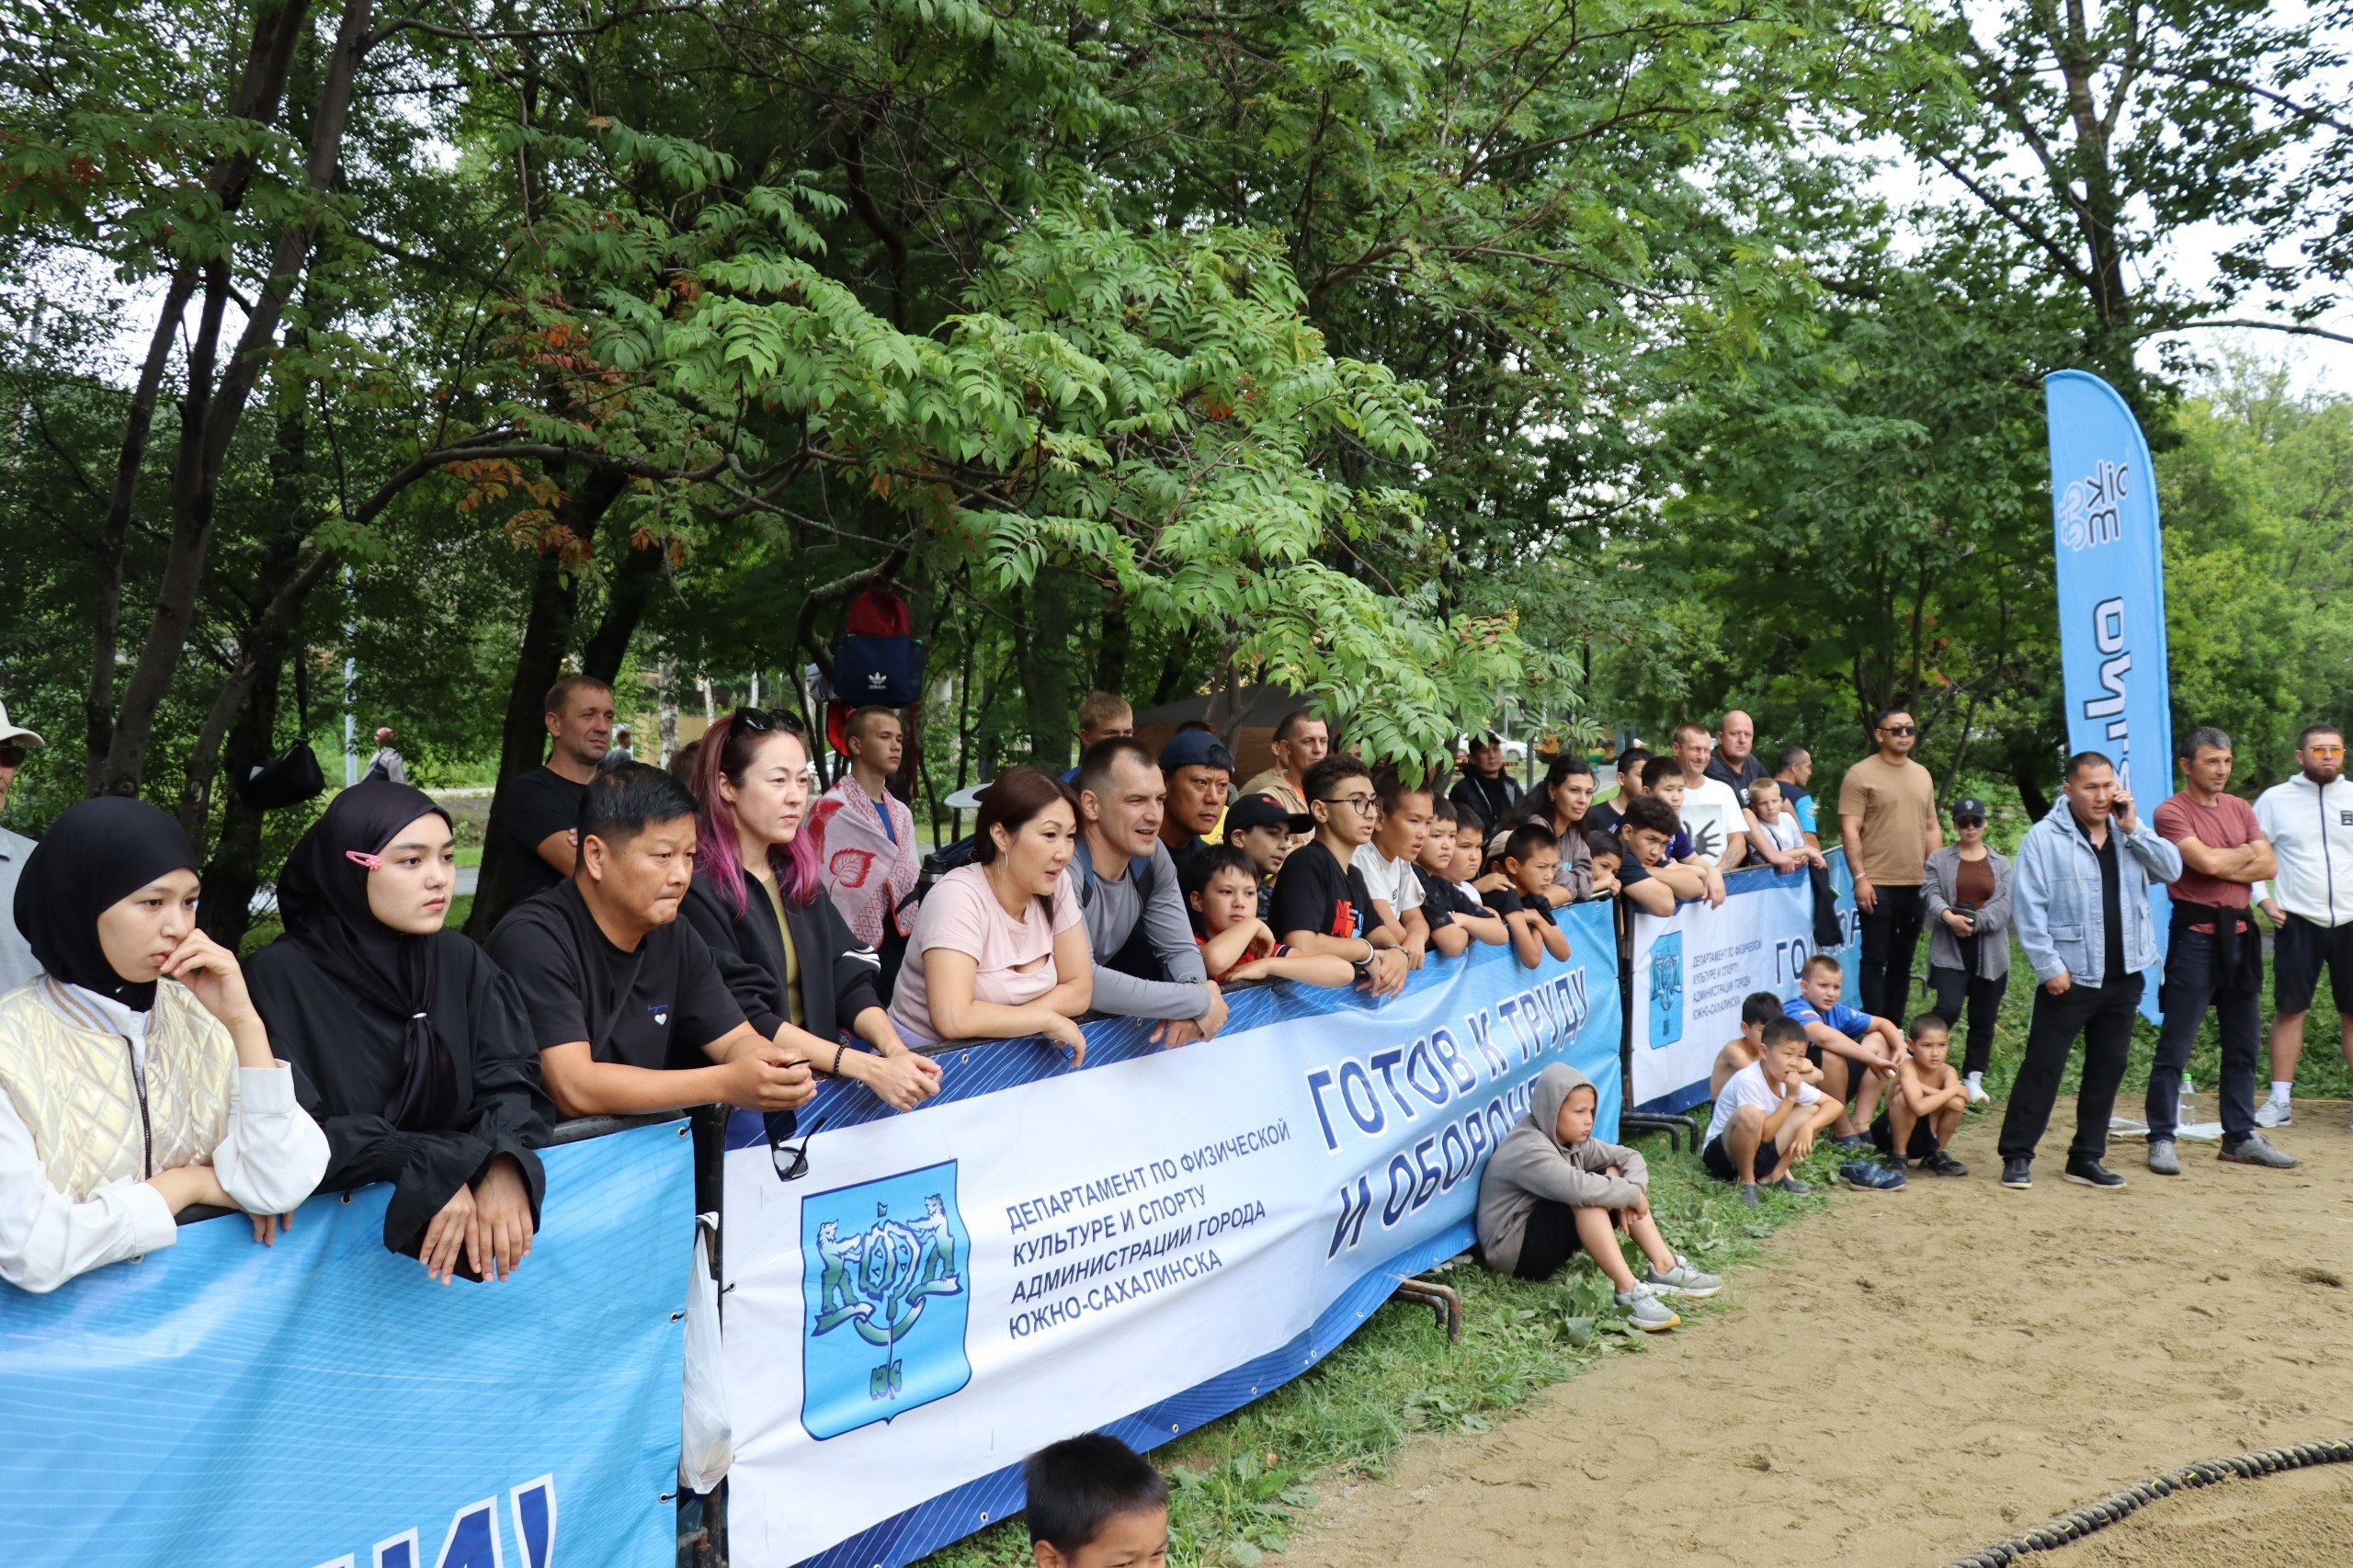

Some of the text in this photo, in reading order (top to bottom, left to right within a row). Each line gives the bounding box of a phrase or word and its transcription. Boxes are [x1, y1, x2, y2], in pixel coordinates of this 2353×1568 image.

[1693, 949, 1727, 968] ДЕПАРТАМЕНТ
[1735, 937, 1763, 955] ФИЗИЧЕСКОЙ
[1693, 962, 1740, 985] КУЛЬТУРЕ И СПОРТУ
[1693, 975, 1752, 1004] АДМИНИСТРАЦИИ ГОРОДА
[1692, 995, 1741, 1020] ЮЖНО-САХАЛИНСКА
[1306, 966, 1587, 1154] ГОТОВ К ТРУДУ
[1006, 1118, 1291, 1234] ДЕПАРТАМЕНТ ПО ФИЗИЧЕСКОЙ
[1326, 1171, 1372, 1264] И
[1011, 1199, 1267, 1304] АДМИНИСТРАЦИИ ГОРОДА
[1013, 1185, 1207, 1267] КУЛЬТУРЕ И СПОРТУ
[1008, 1248, 1223, 1340] ЮЖНО-САХАЛИНСКА
